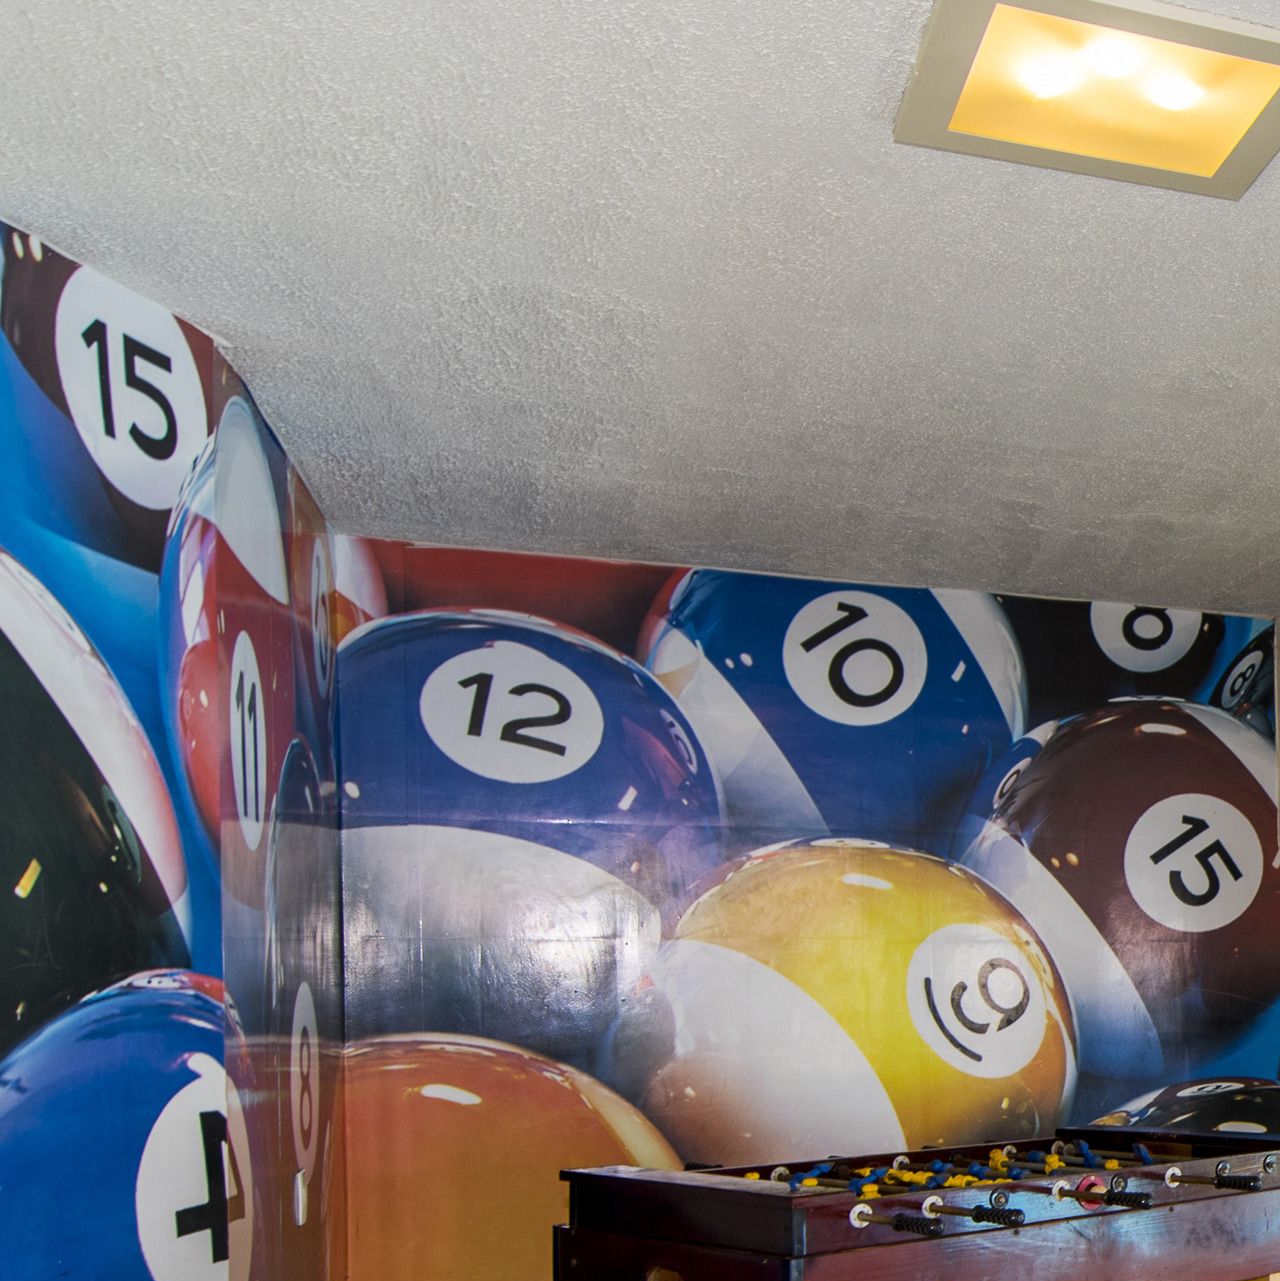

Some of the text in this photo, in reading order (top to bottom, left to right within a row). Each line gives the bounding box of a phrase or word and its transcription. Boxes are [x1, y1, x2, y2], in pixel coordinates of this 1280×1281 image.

[81, 318, 178, 461] 15
[800, 601, 904, 708] 10
[235, 671, 259, 823] 11
[457, 672, 572, 757] 12
[1149, 814, 1243, 907] 15
